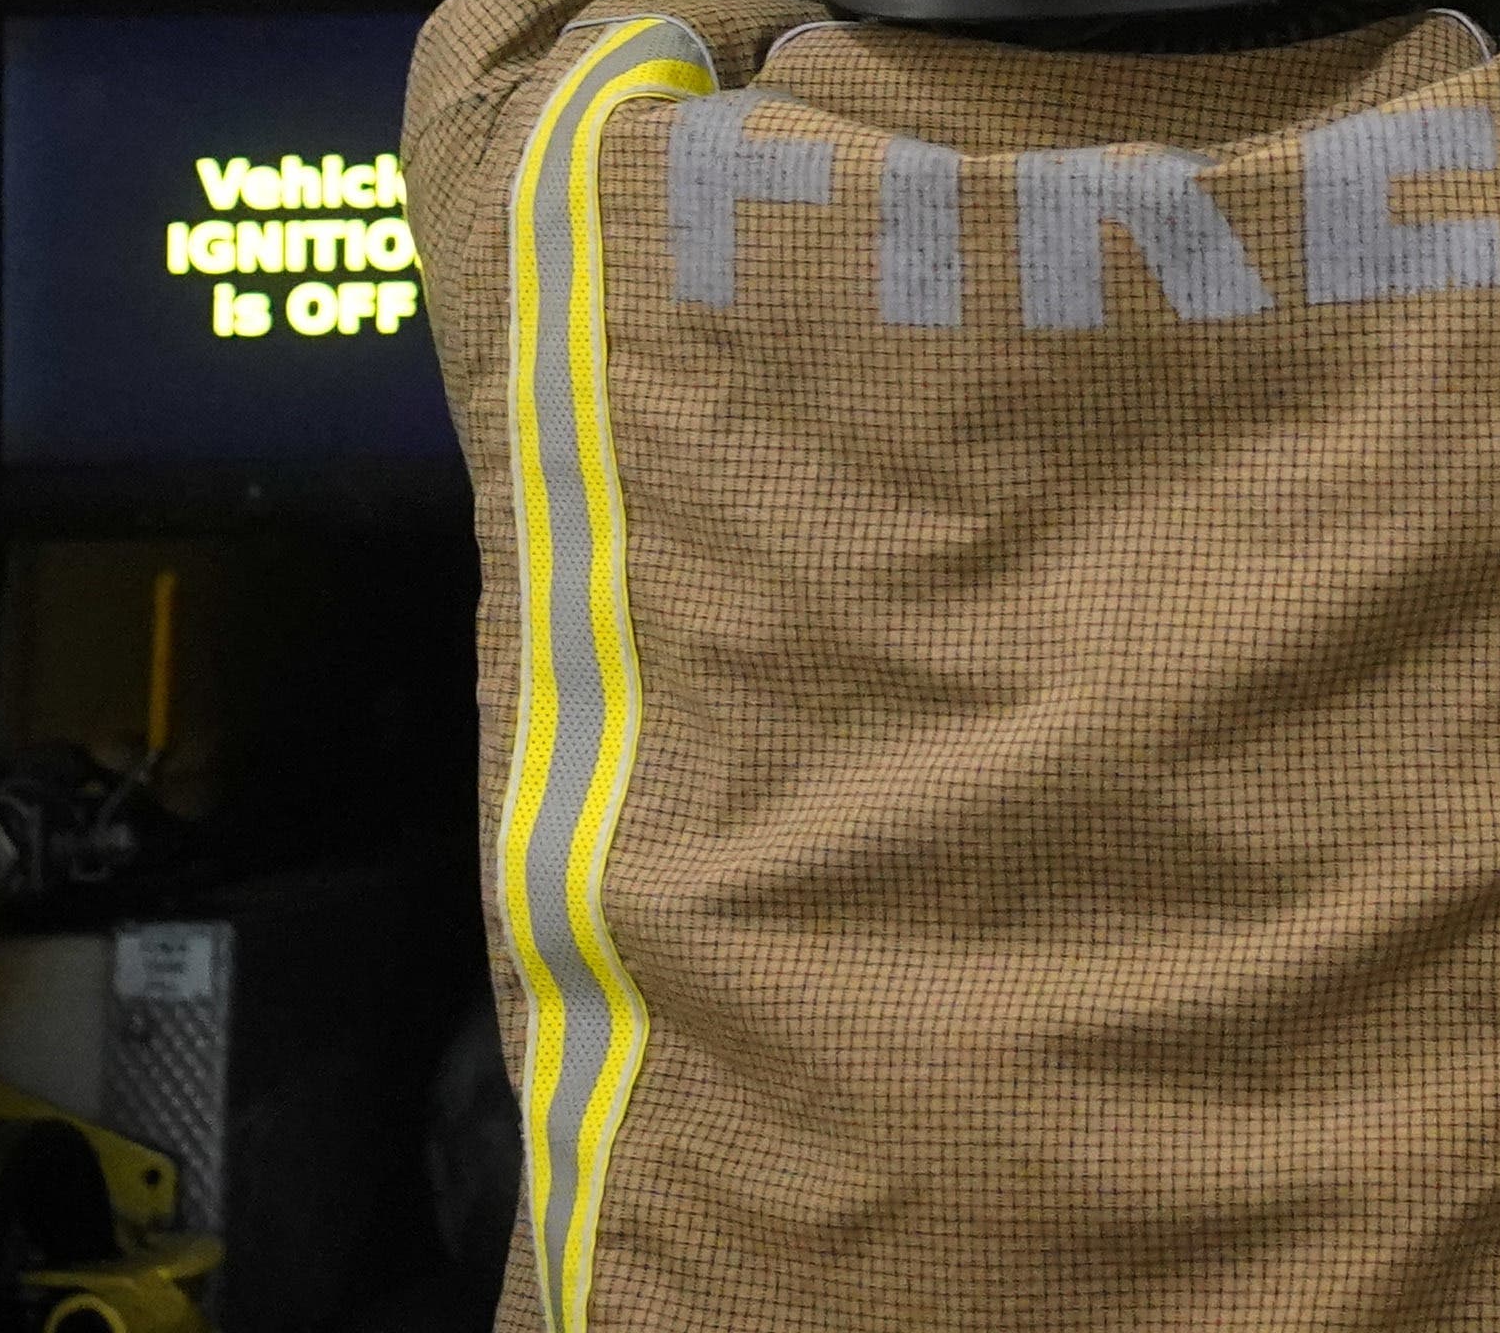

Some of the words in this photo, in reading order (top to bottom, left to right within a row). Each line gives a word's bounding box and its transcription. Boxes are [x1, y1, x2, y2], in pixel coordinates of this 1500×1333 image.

[195, 153, 406, 212] Vehicl
[166, 217, 424, 276] IGNITIO
[285, 280, 418, 337] OFF
